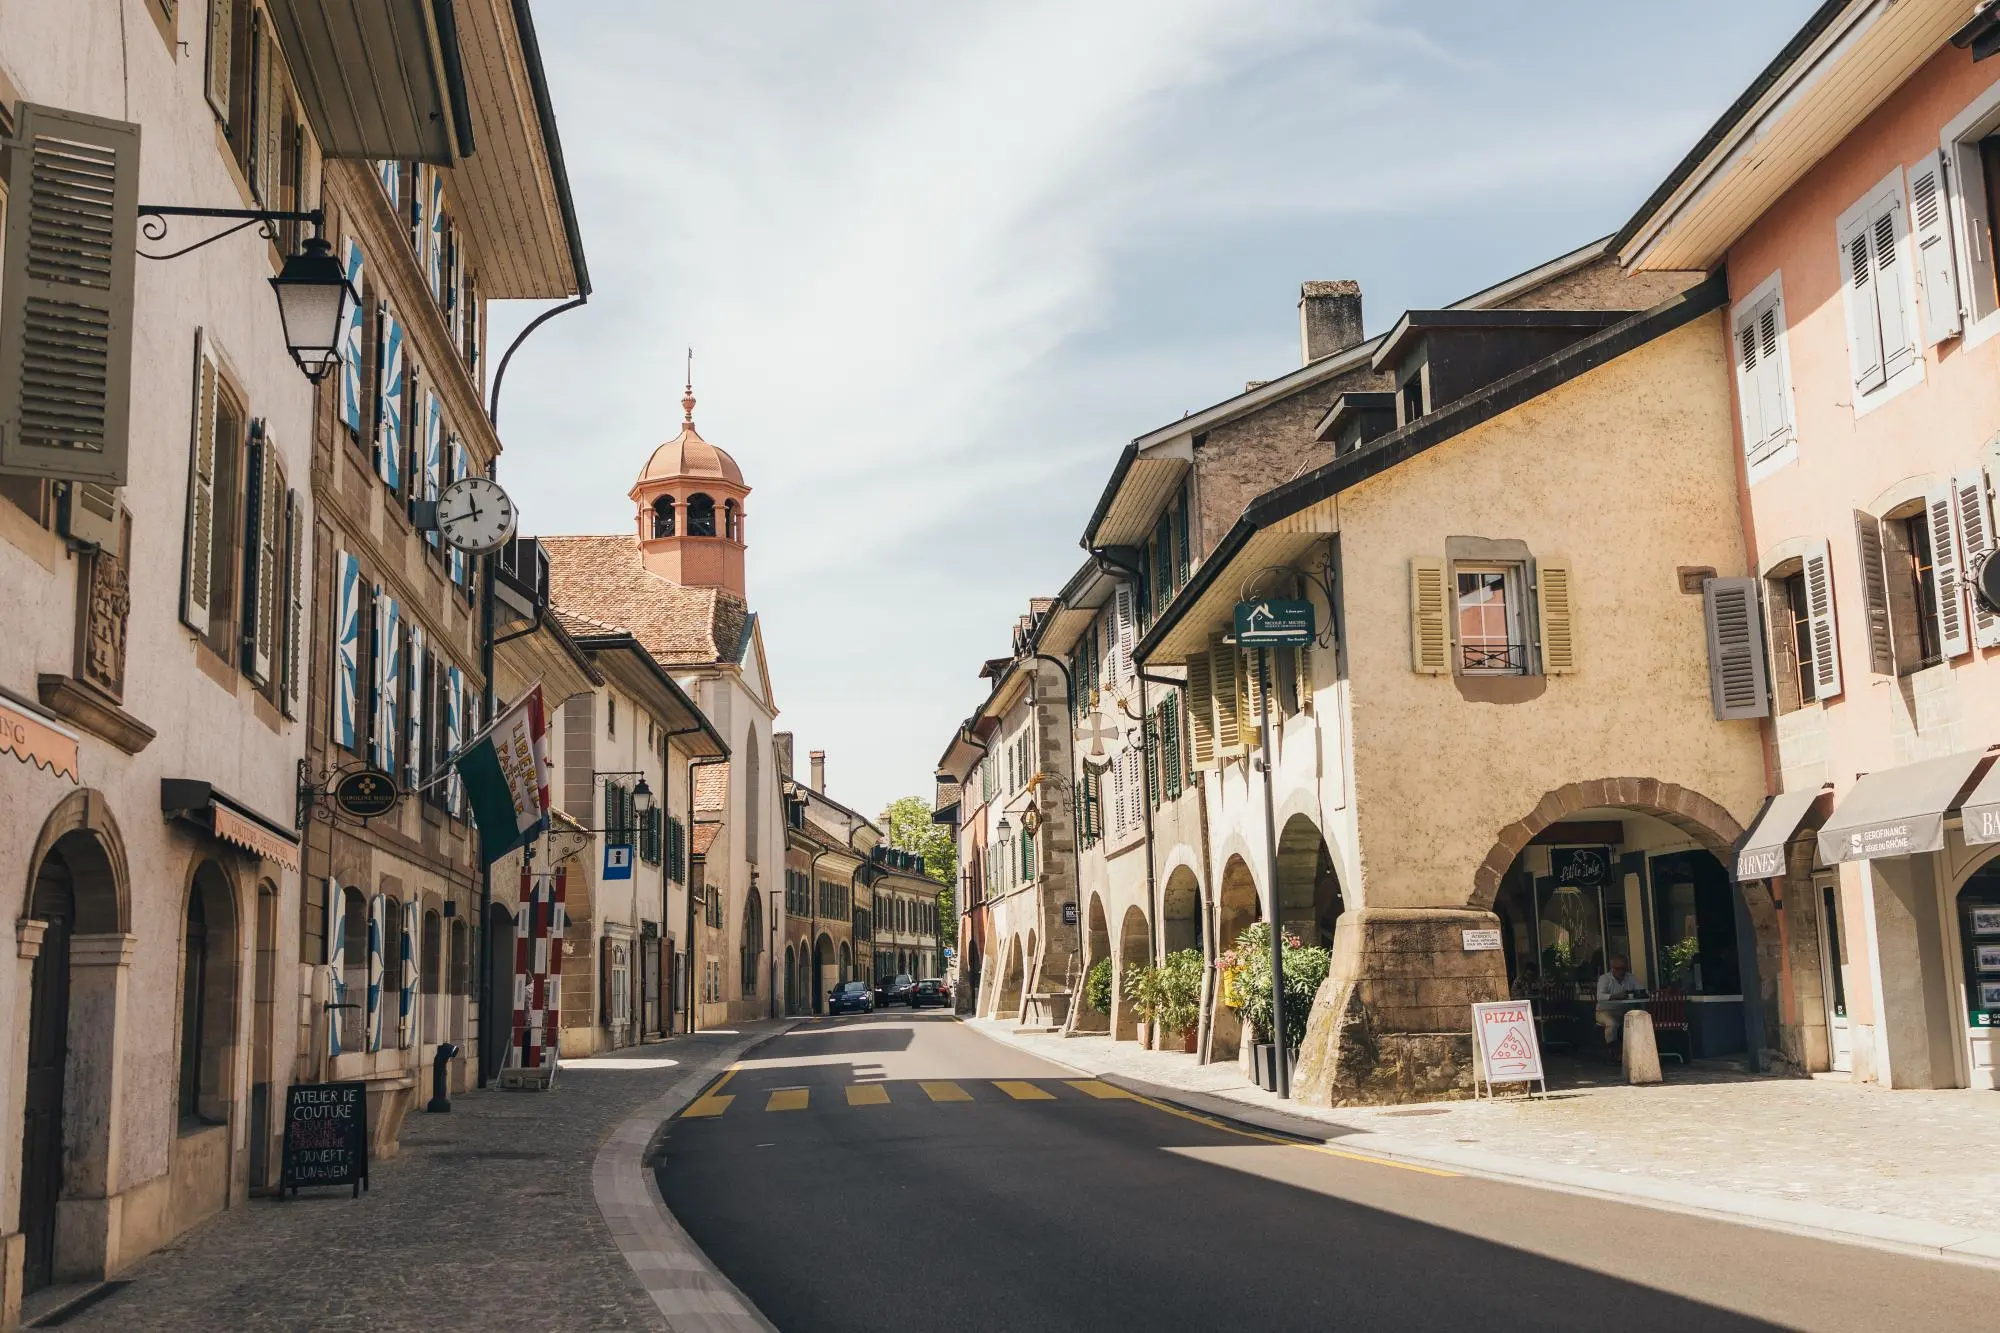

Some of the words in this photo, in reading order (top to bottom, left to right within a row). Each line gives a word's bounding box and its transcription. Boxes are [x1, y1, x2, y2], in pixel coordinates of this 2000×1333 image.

[1864, 825, 1907, 841] GEROFINANCE
[1737, 852, 1775, 876] BARNES
[1484, 1011, 1526, 1024] PIZZA
[294, 1090, 338, 1104] ATELIER
[343, 1089, 358, 1102] DE
[293, 1104, 353, 1120] COUTURE
[300, 1149, 345, 1163] OUVERT
